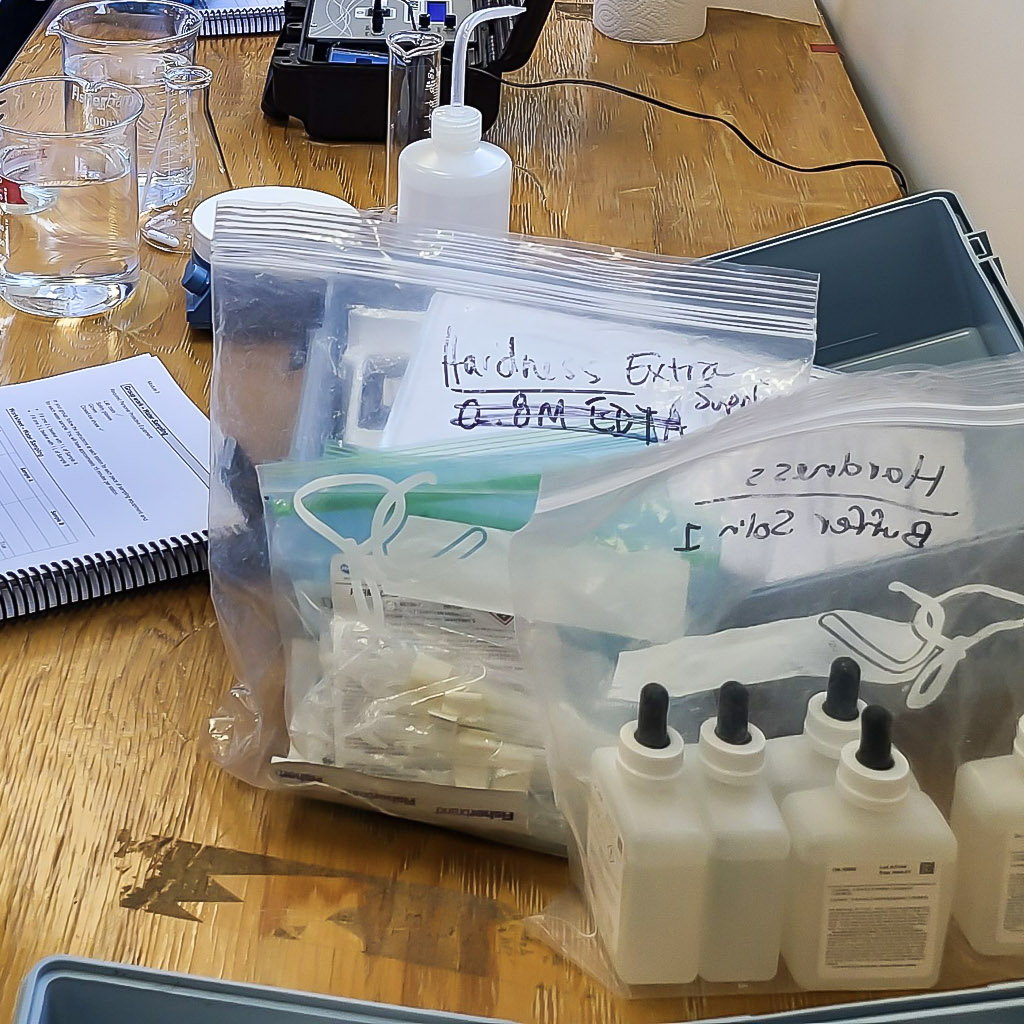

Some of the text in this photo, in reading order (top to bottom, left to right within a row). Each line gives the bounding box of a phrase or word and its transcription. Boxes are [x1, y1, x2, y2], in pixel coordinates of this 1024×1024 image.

[442, 326, 736, 388] Hardness Extra
[124, 385, 135, 397] Group
[152, 419, 168, 436] Sampling
[435, 807, 515, 822] Fisherbrand
